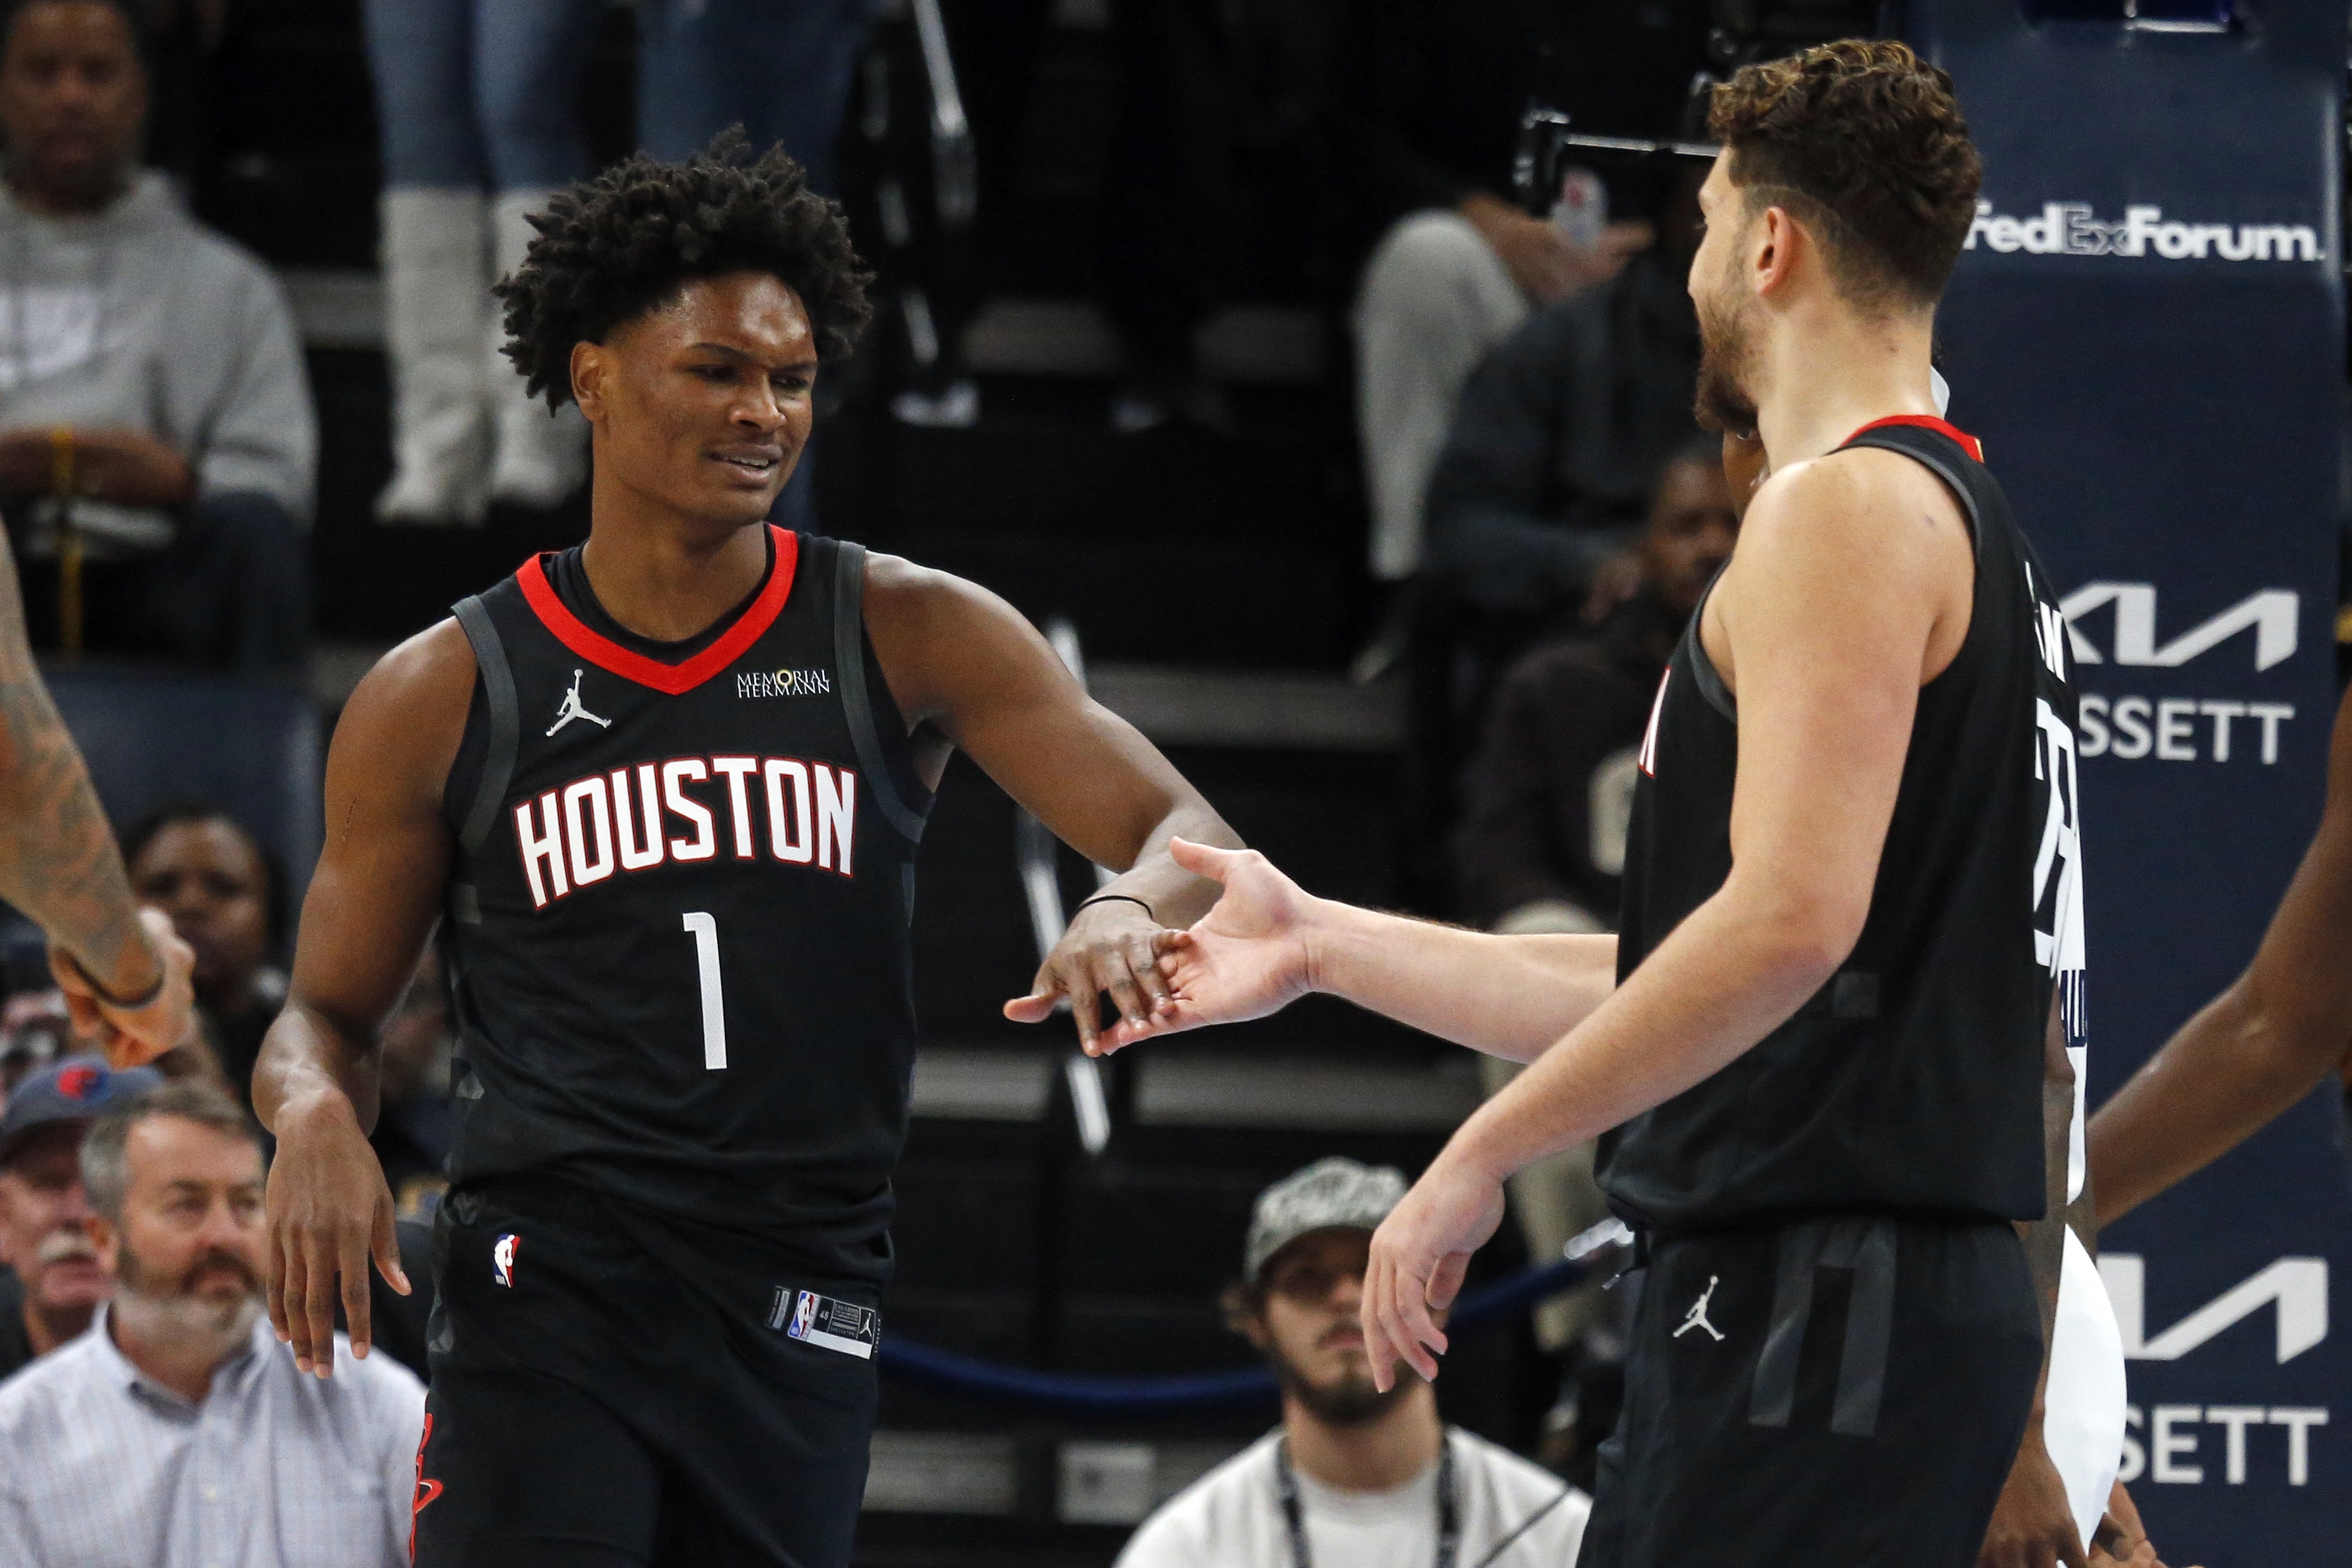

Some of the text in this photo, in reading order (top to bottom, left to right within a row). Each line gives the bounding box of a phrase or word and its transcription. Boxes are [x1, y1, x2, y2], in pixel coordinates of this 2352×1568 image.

[737, 669, 830, 687] MEMORIAL
[738, 680, 831, 699] HERMANN
[2079, 693, 2296, 765] SSETT
[513, 755, 858, 912] HOUSTON
[683, 911, 727, 1070] 1
